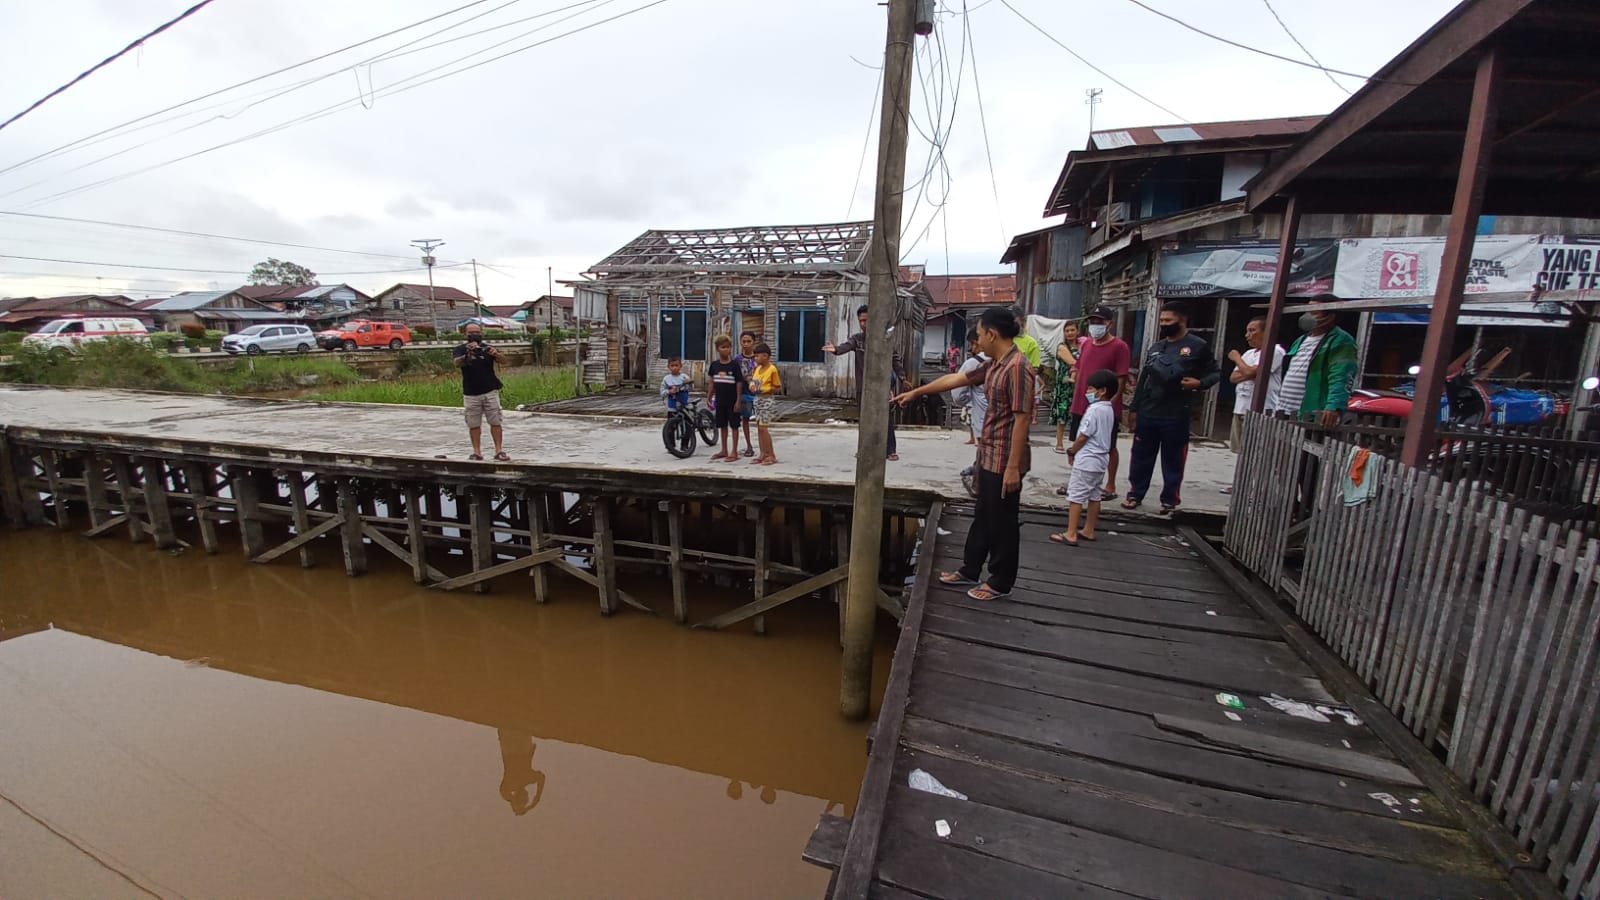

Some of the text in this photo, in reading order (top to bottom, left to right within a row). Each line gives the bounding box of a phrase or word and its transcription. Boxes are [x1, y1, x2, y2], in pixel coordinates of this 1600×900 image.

[1542, 248, 1592, 272] YANG
[1466, 276, 1490, 284] AYS.
[1536, 272, 1600, 290] GUE TE
